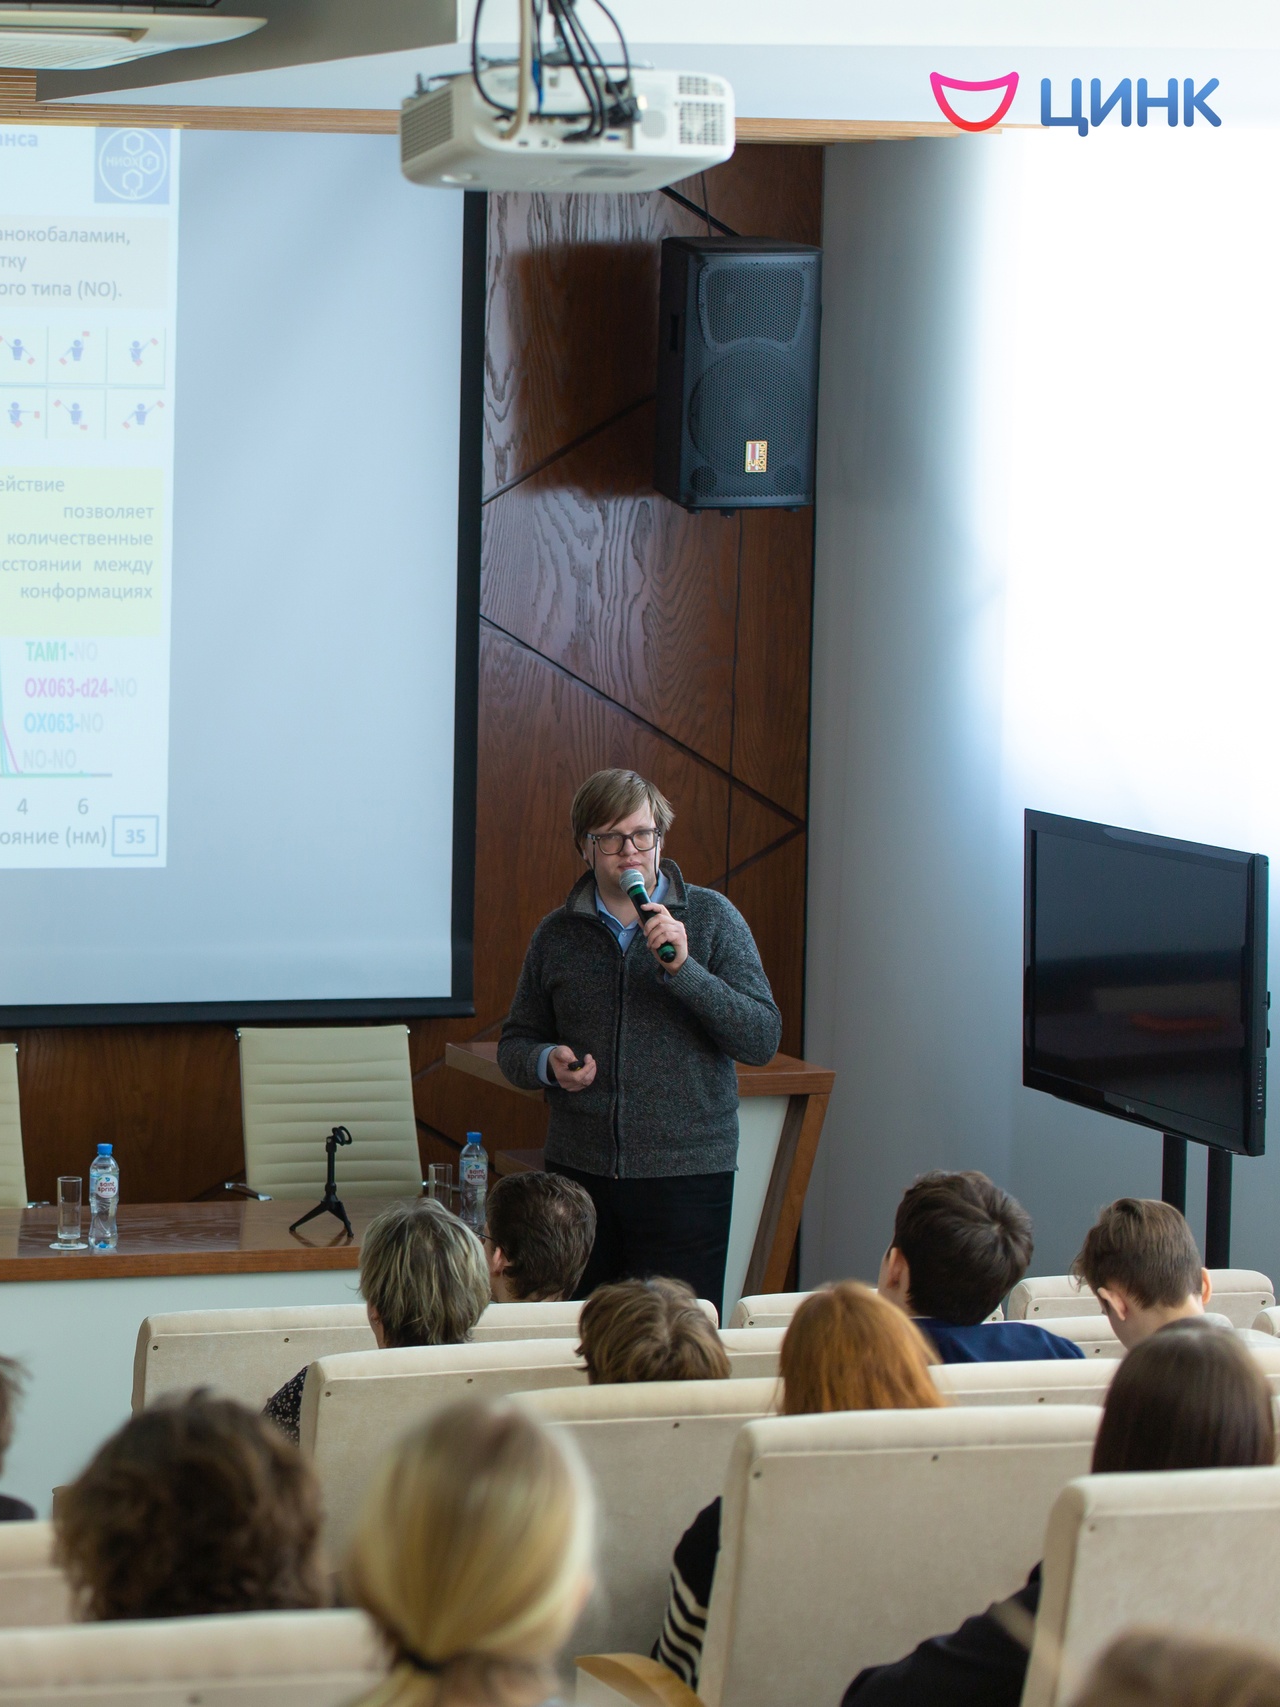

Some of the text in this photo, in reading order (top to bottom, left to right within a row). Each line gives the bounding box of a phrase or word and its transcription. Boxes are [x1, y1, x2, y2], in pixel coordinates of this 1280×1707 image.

[31, 284, 71, 296] типа
[63, 507, 154, 519] позволяет
[7, 533, 153, 545] количественные
[94, 560, 153, 575] между
[20, 582, 152, 602] конформациях
[17, 798, 28, 814] 4
[77, 798, 89, 815] 6
[66, 826, 107, 848] (нм)
[126, 829, 145, 844] 35
